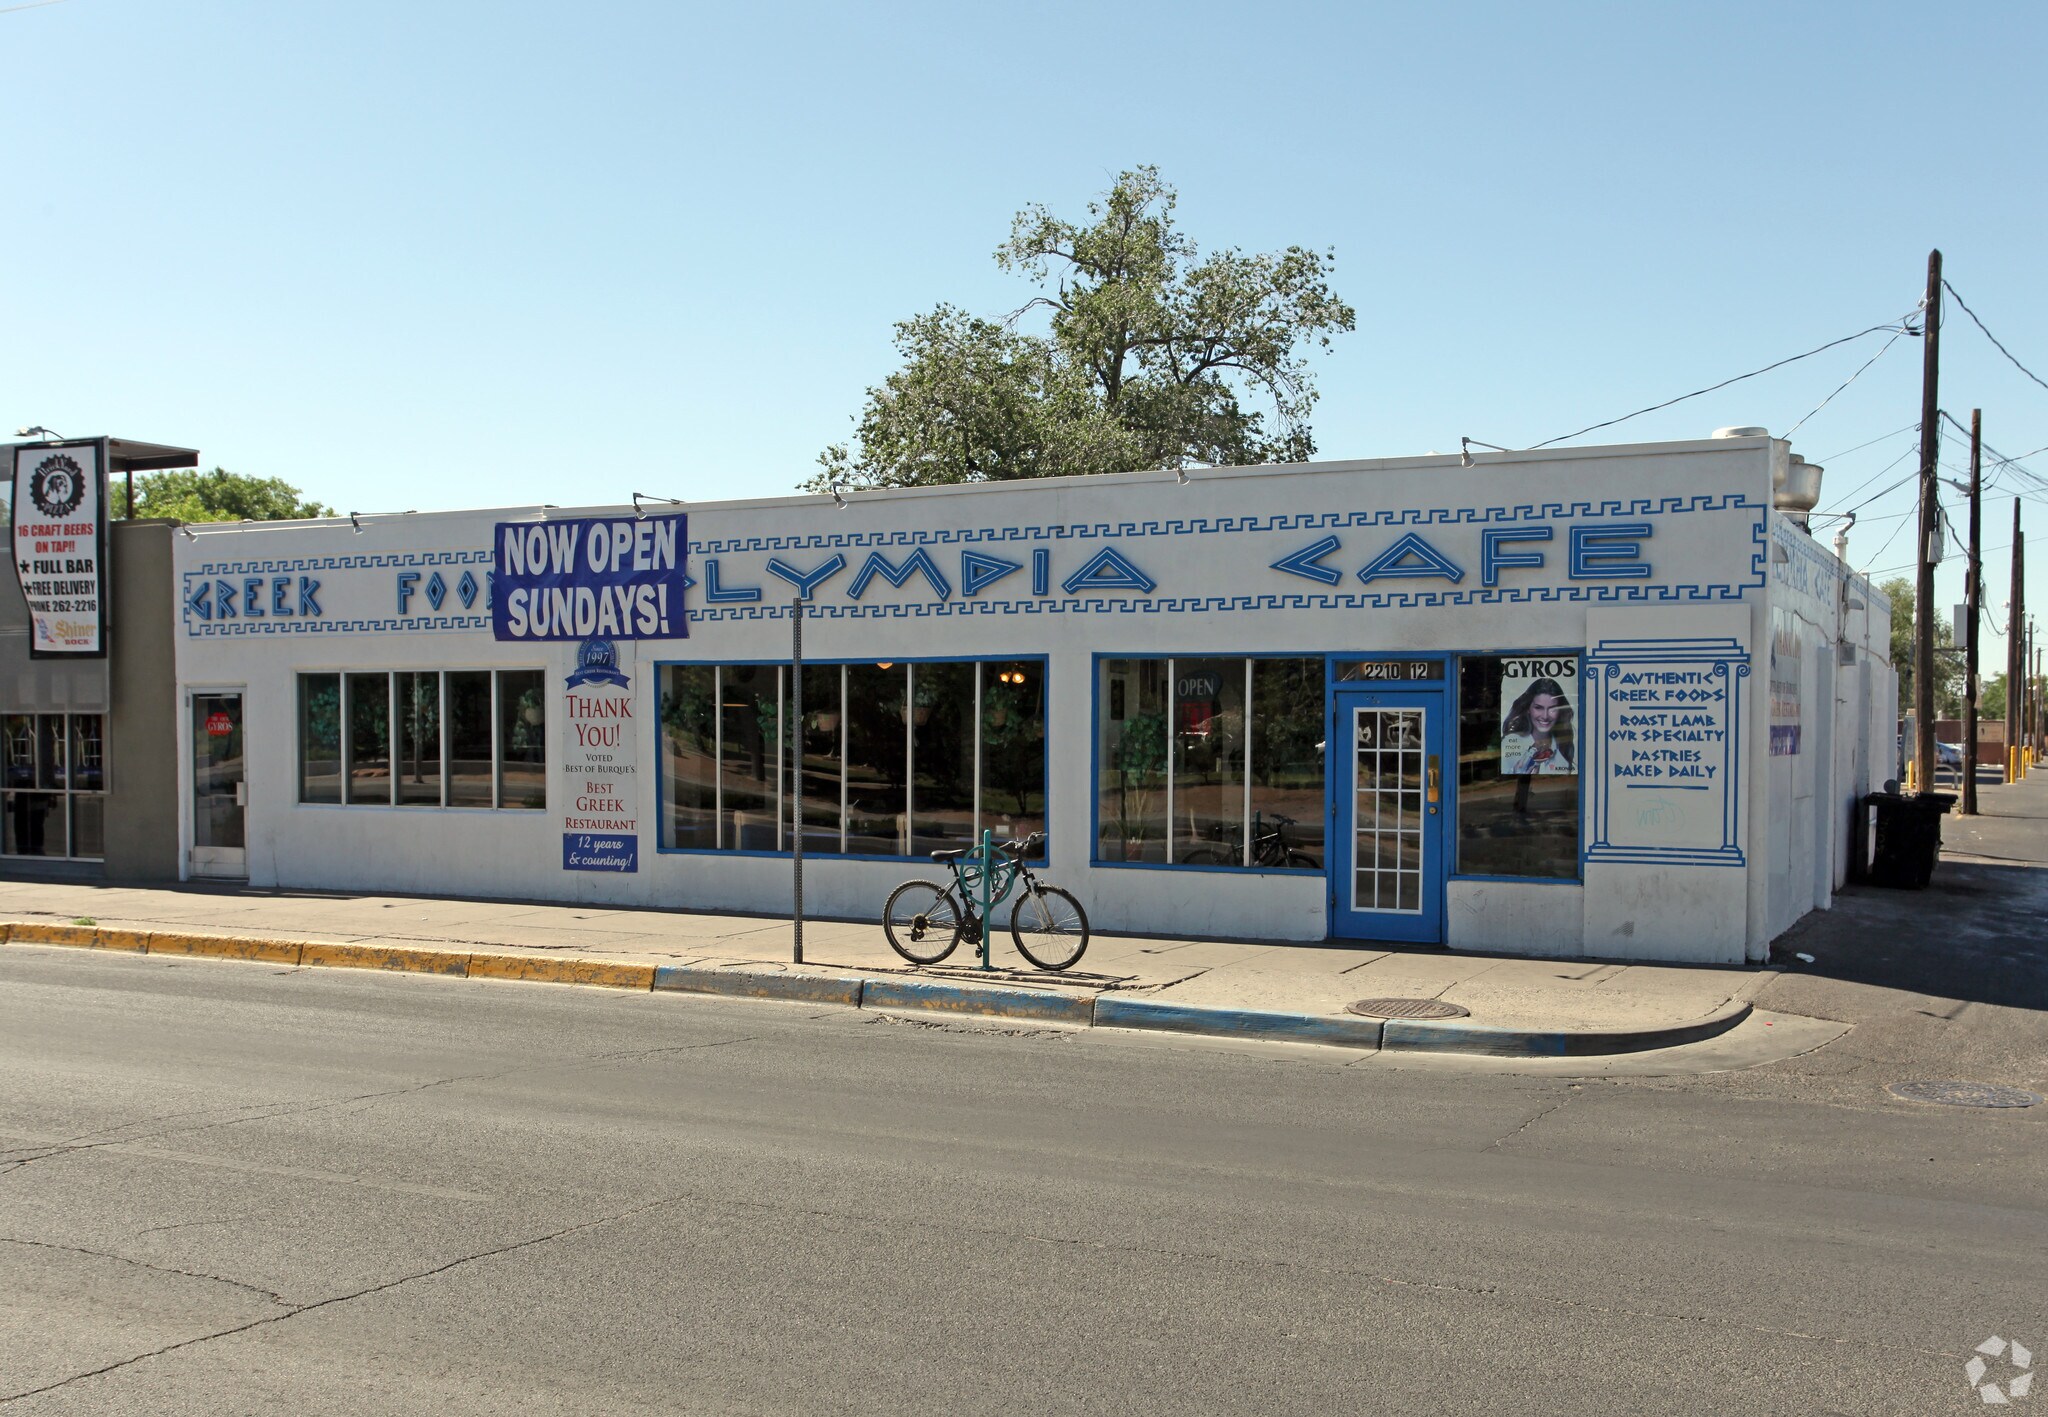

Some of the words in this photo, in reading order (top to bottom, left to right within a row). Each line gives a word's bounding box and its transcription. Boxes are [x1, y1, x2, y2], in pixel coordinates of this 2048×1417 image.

[18, 525, 29, 537] 16
[31, 524, 62, 537] CRAFT
[64, 523, 94, 536] BEERS
[35, 541, 49, 554] ON
[51, 541, 76, 553] TAP!!
[504, 524, 580, 577] NOW
[586, 518, 678, 574] OPEN
[33, 560, 63, 575] FULL
[66, 559, 94, 574] BAR
[188, 576, 323, 621] GREEK
[687, 546, 1157, 604] LYMPIA
[1268, 522, 1653, 588] CAFE
[32, 581, 52, 596] FREE
[53, 580, 96, 596] DELIVERY
[52, 600, 97, 613] 262-2216
[506, 583, 671, 638] SUNDAYS!
[55, 619, 97, 638] Shiner
[64, 638, 90, 646] BOCK
[586, 651, 610, 664] 1997
[1365, 663, 1400, 679] 2210
[1411, 663, 1427, 679] 12
[1503, 659, 1576, 679] GYROS
[1178, 678, 1214, 697] OPEN
[1609, 688, 1661, 702] GREEK
[1664, 688, 1725, 703] FOODS
[565, 695, 633, 718] THANK
[208, 722, 233, 732] GYROS
[1620, 714, 1668, 727] ROAST
[1672, 714, 1716, 727] LAMB
[575, 723, 620, 747] YOU!
[1640, 729, 1725, 742] SPECIALTY
[585, 753, 613, 762] VOTED
[1504, 751, 1522, 759] gyros
[1631, 749, 1702, 763] PASTRIES
[565, 764, 582, 773] BEST
[585, 765, 595, 773] OF
[597, 764, 635, 775] BURQUE'S
[1614, 763, 1663, 778] BAKED
[1669, 764, 1717, 779] DAILY
[586, 781, 614, 794] BEST
[576, 796, 625, 812] GREEK
[565, 816, 637, 831] RESTAURANT
[578, 835, 591, 849] 12
[593, 839, 624, 853] years
[569, 851, 581, 865] &
[582, 853, 633, 871] counting!
